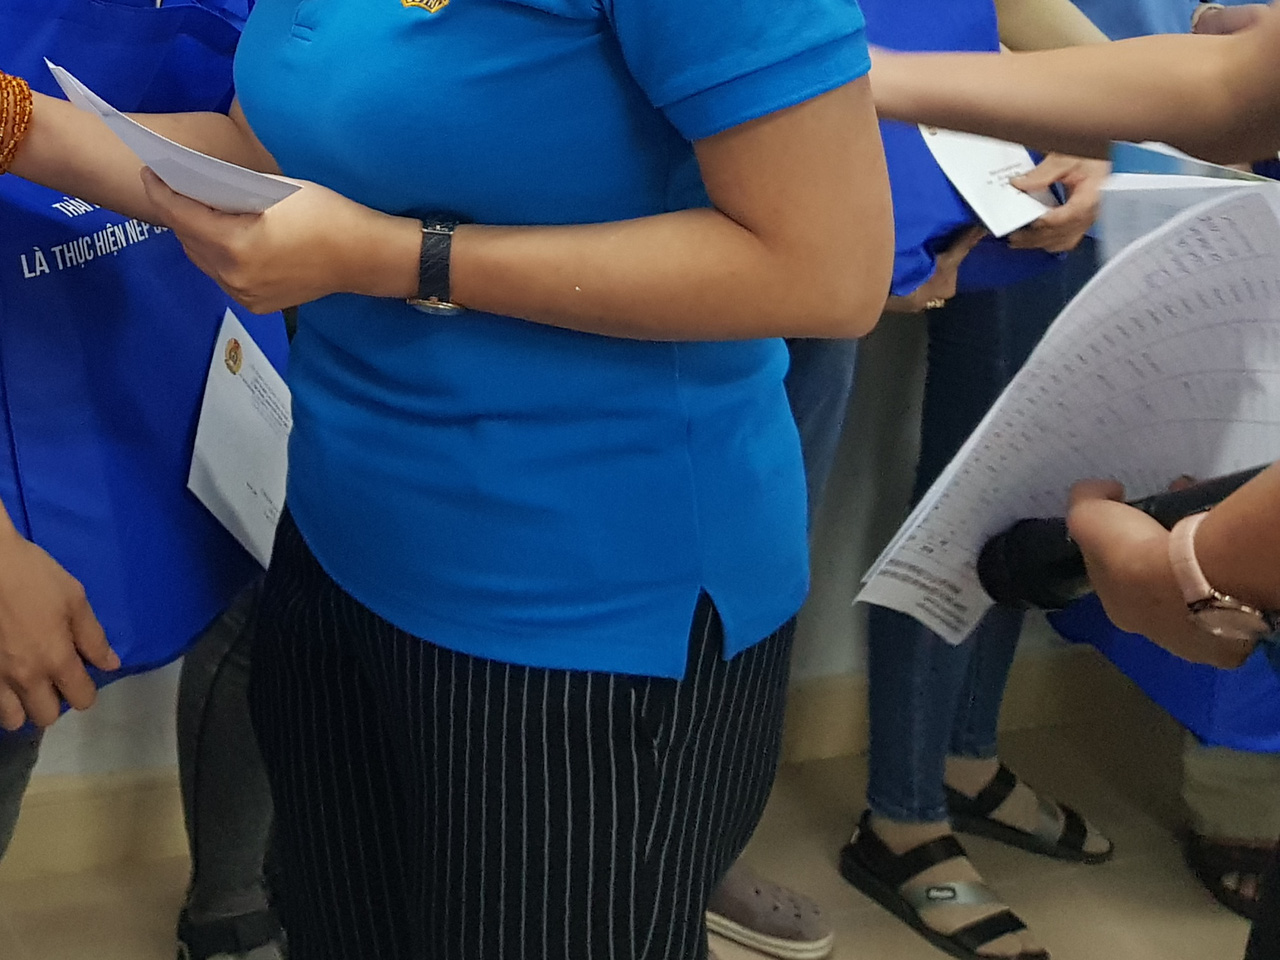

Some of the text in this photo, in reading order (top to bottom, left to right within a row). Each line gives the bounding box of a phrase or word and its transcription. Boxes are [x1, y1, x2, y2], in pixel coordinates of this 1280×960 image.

[52, 196, 94, 218] THẢI
[20, 246, 51, 279] LÀ
[50, 236, 94, 269] THỰC
[93, 222, 128, 257] HIỆN
